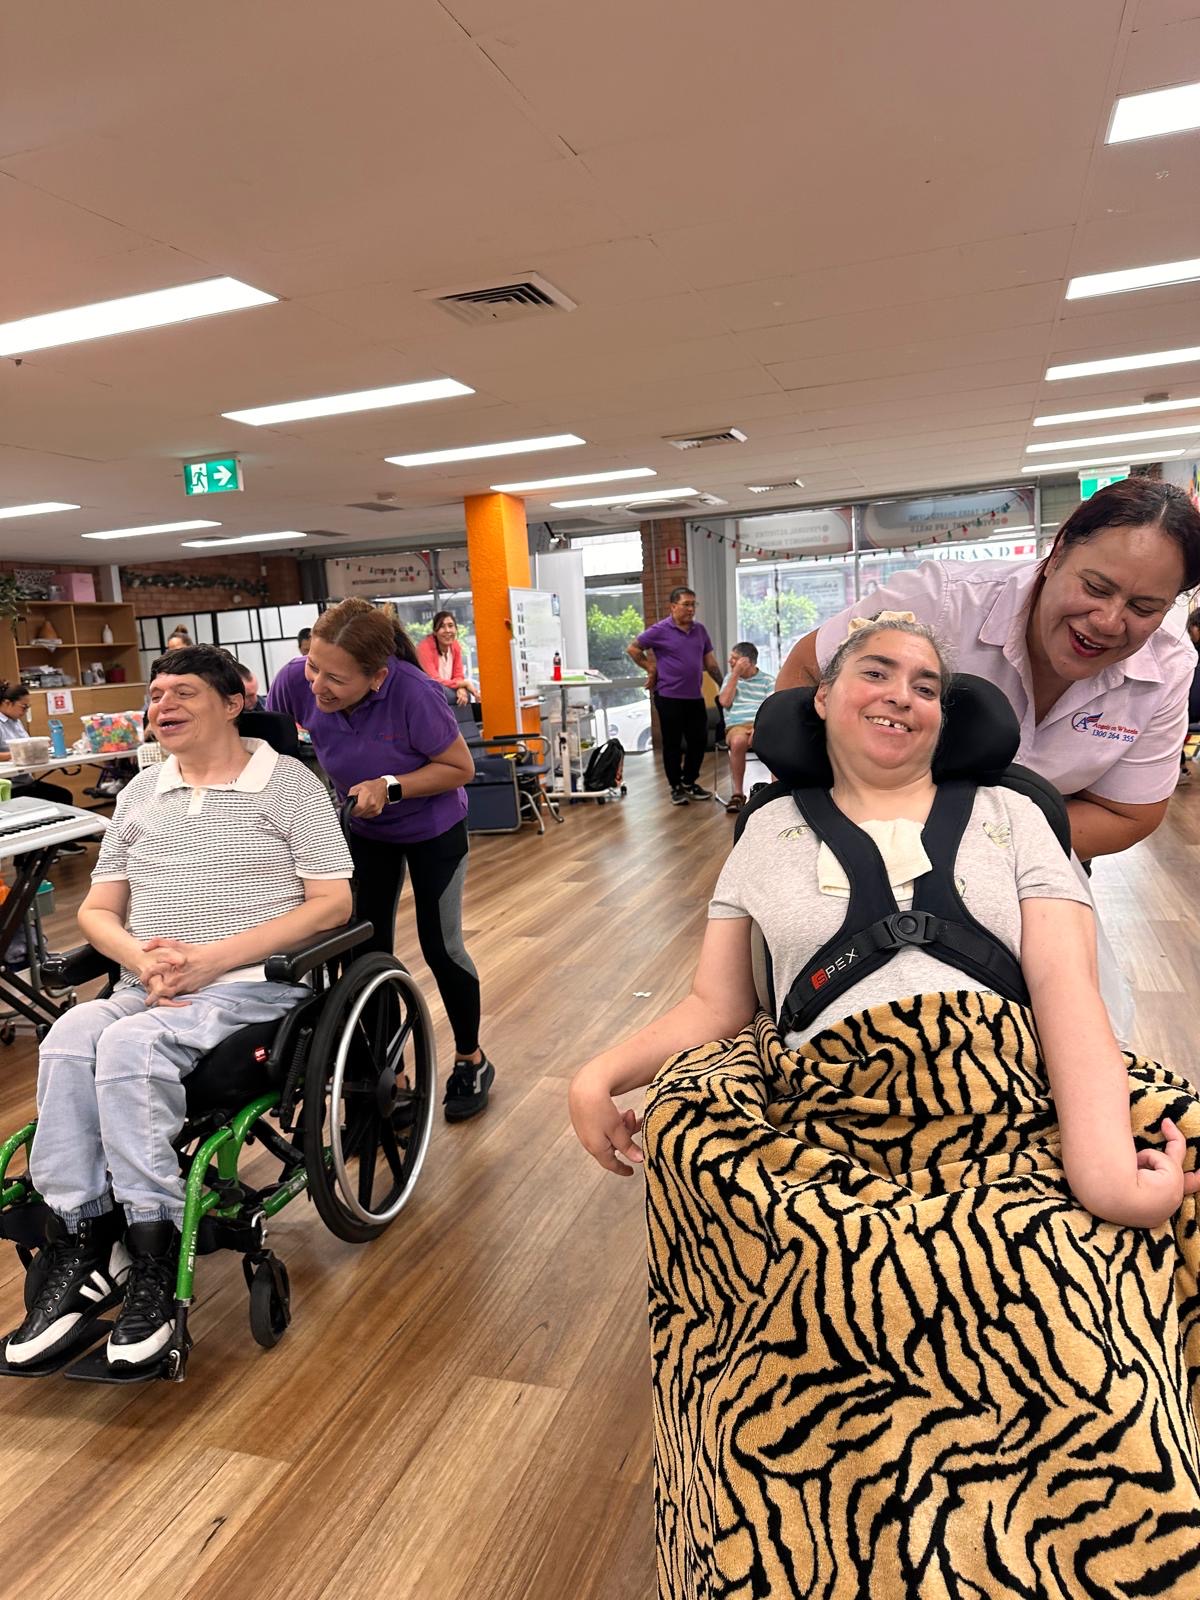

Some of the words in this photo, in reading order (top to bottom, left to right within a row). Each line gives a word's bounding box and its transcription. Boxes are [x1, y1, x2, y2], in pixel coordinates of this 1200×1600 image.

[1092, 723, 1110, 731] Angels
[1117, 725, 1138, 735] Wheels
[1092, 729, 1107, 738] 1300
[1108, 732, 1120, 740] 264
[1122, 734, 1135, 743] 355
